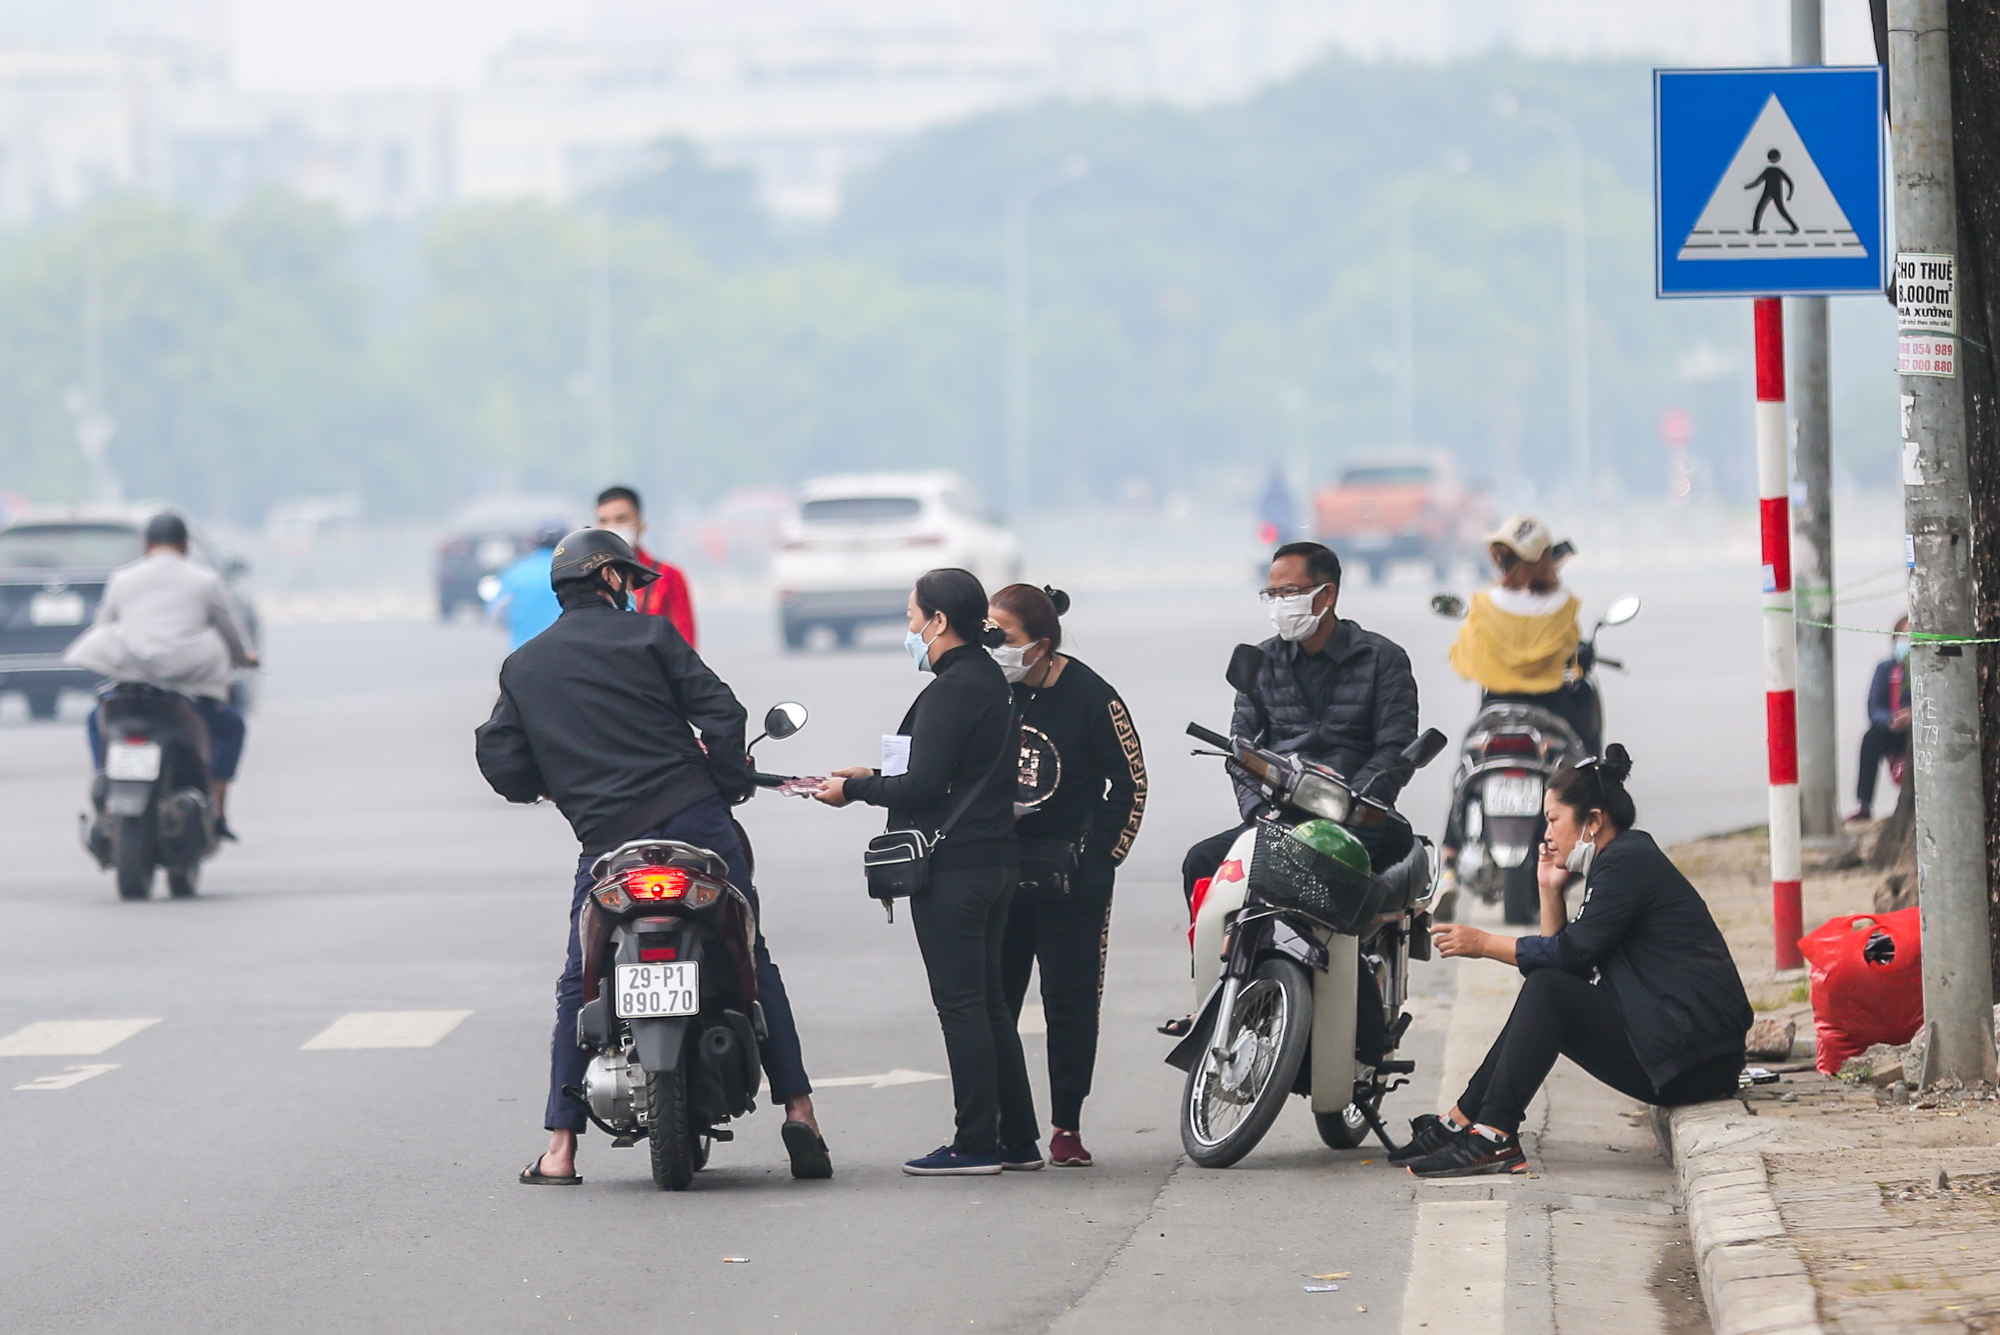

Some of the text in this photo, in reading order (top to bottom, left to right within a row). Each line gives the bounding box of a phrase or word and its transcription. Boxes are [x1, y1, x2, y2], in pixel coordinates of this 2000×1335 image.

[1920, 260, 1953, 281] THUÊ
[1914, 306, 1953, 319] XƯỞNG
[1912, 343, 1932, 355] 054
[1935, 344, 1953, 356] 989
[1912, 359, 1931, 371] 000
[1934, 360, 1953, 372] 880
[629, 966, 684, 990] 29-P1
[623, 990, 693, 1014] 890.70
